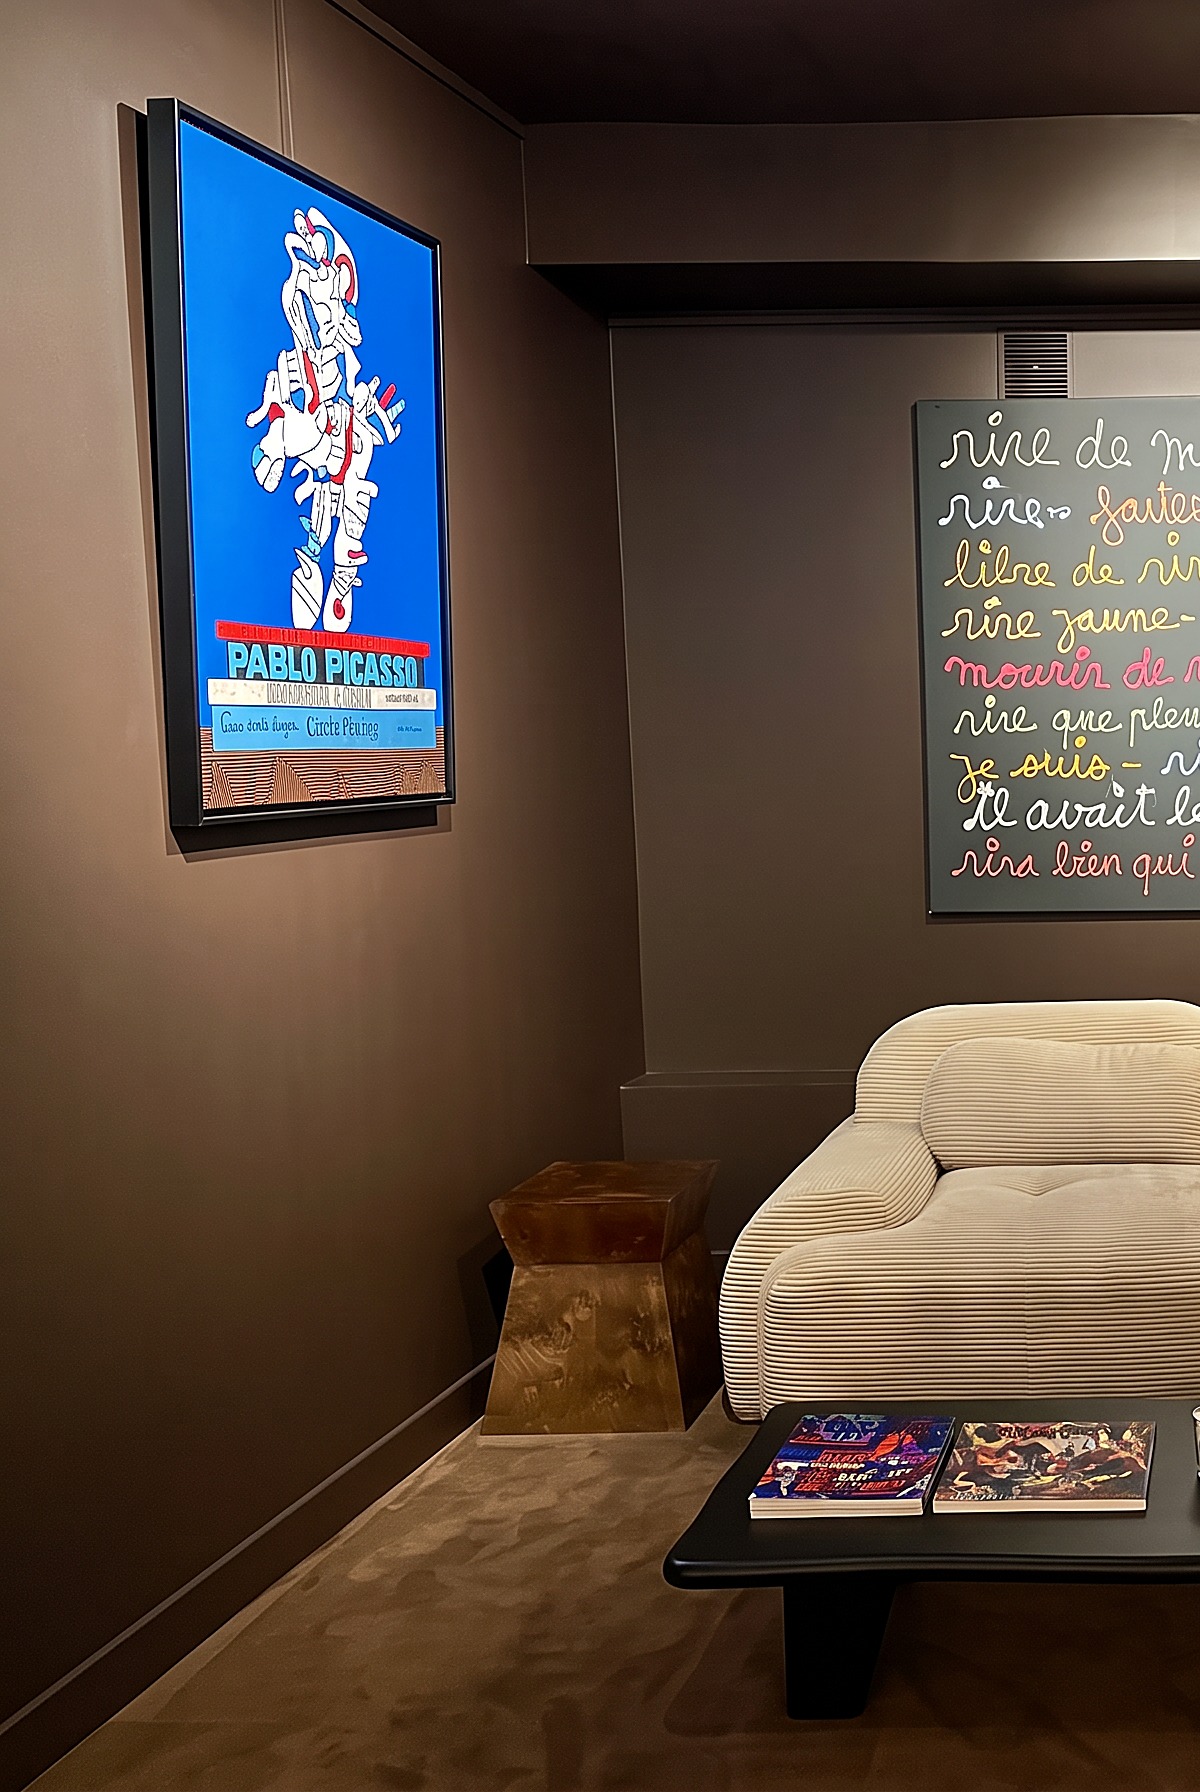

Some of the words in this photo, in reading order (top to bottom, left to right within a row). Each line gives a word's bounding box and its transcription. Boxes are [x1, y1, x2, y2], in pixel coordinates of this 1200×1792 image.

[939, 411, 1061, 469] rire
[1075, 417, 1132, 469] de
[943, 539, 1056, 589] libre
[1072, 545, 1125, 587] de
[941, 596, 1042, 640] rire
[227, 641, 318, 683] PABLO
[324, 648, 418, 688] PICASSO
[943, 645, 1111, 690] mourir
[1122, 647, 1175, 690] de
[953, 694, 1038, 737] rire
[1051, 708, 1123, 750] que
[1025, 778, 1156, 831] avait
[951, 836, 1040, 879] rira
[1051, 840, 1123, 879] bien
[1132, 833, 1196, 896] qui
